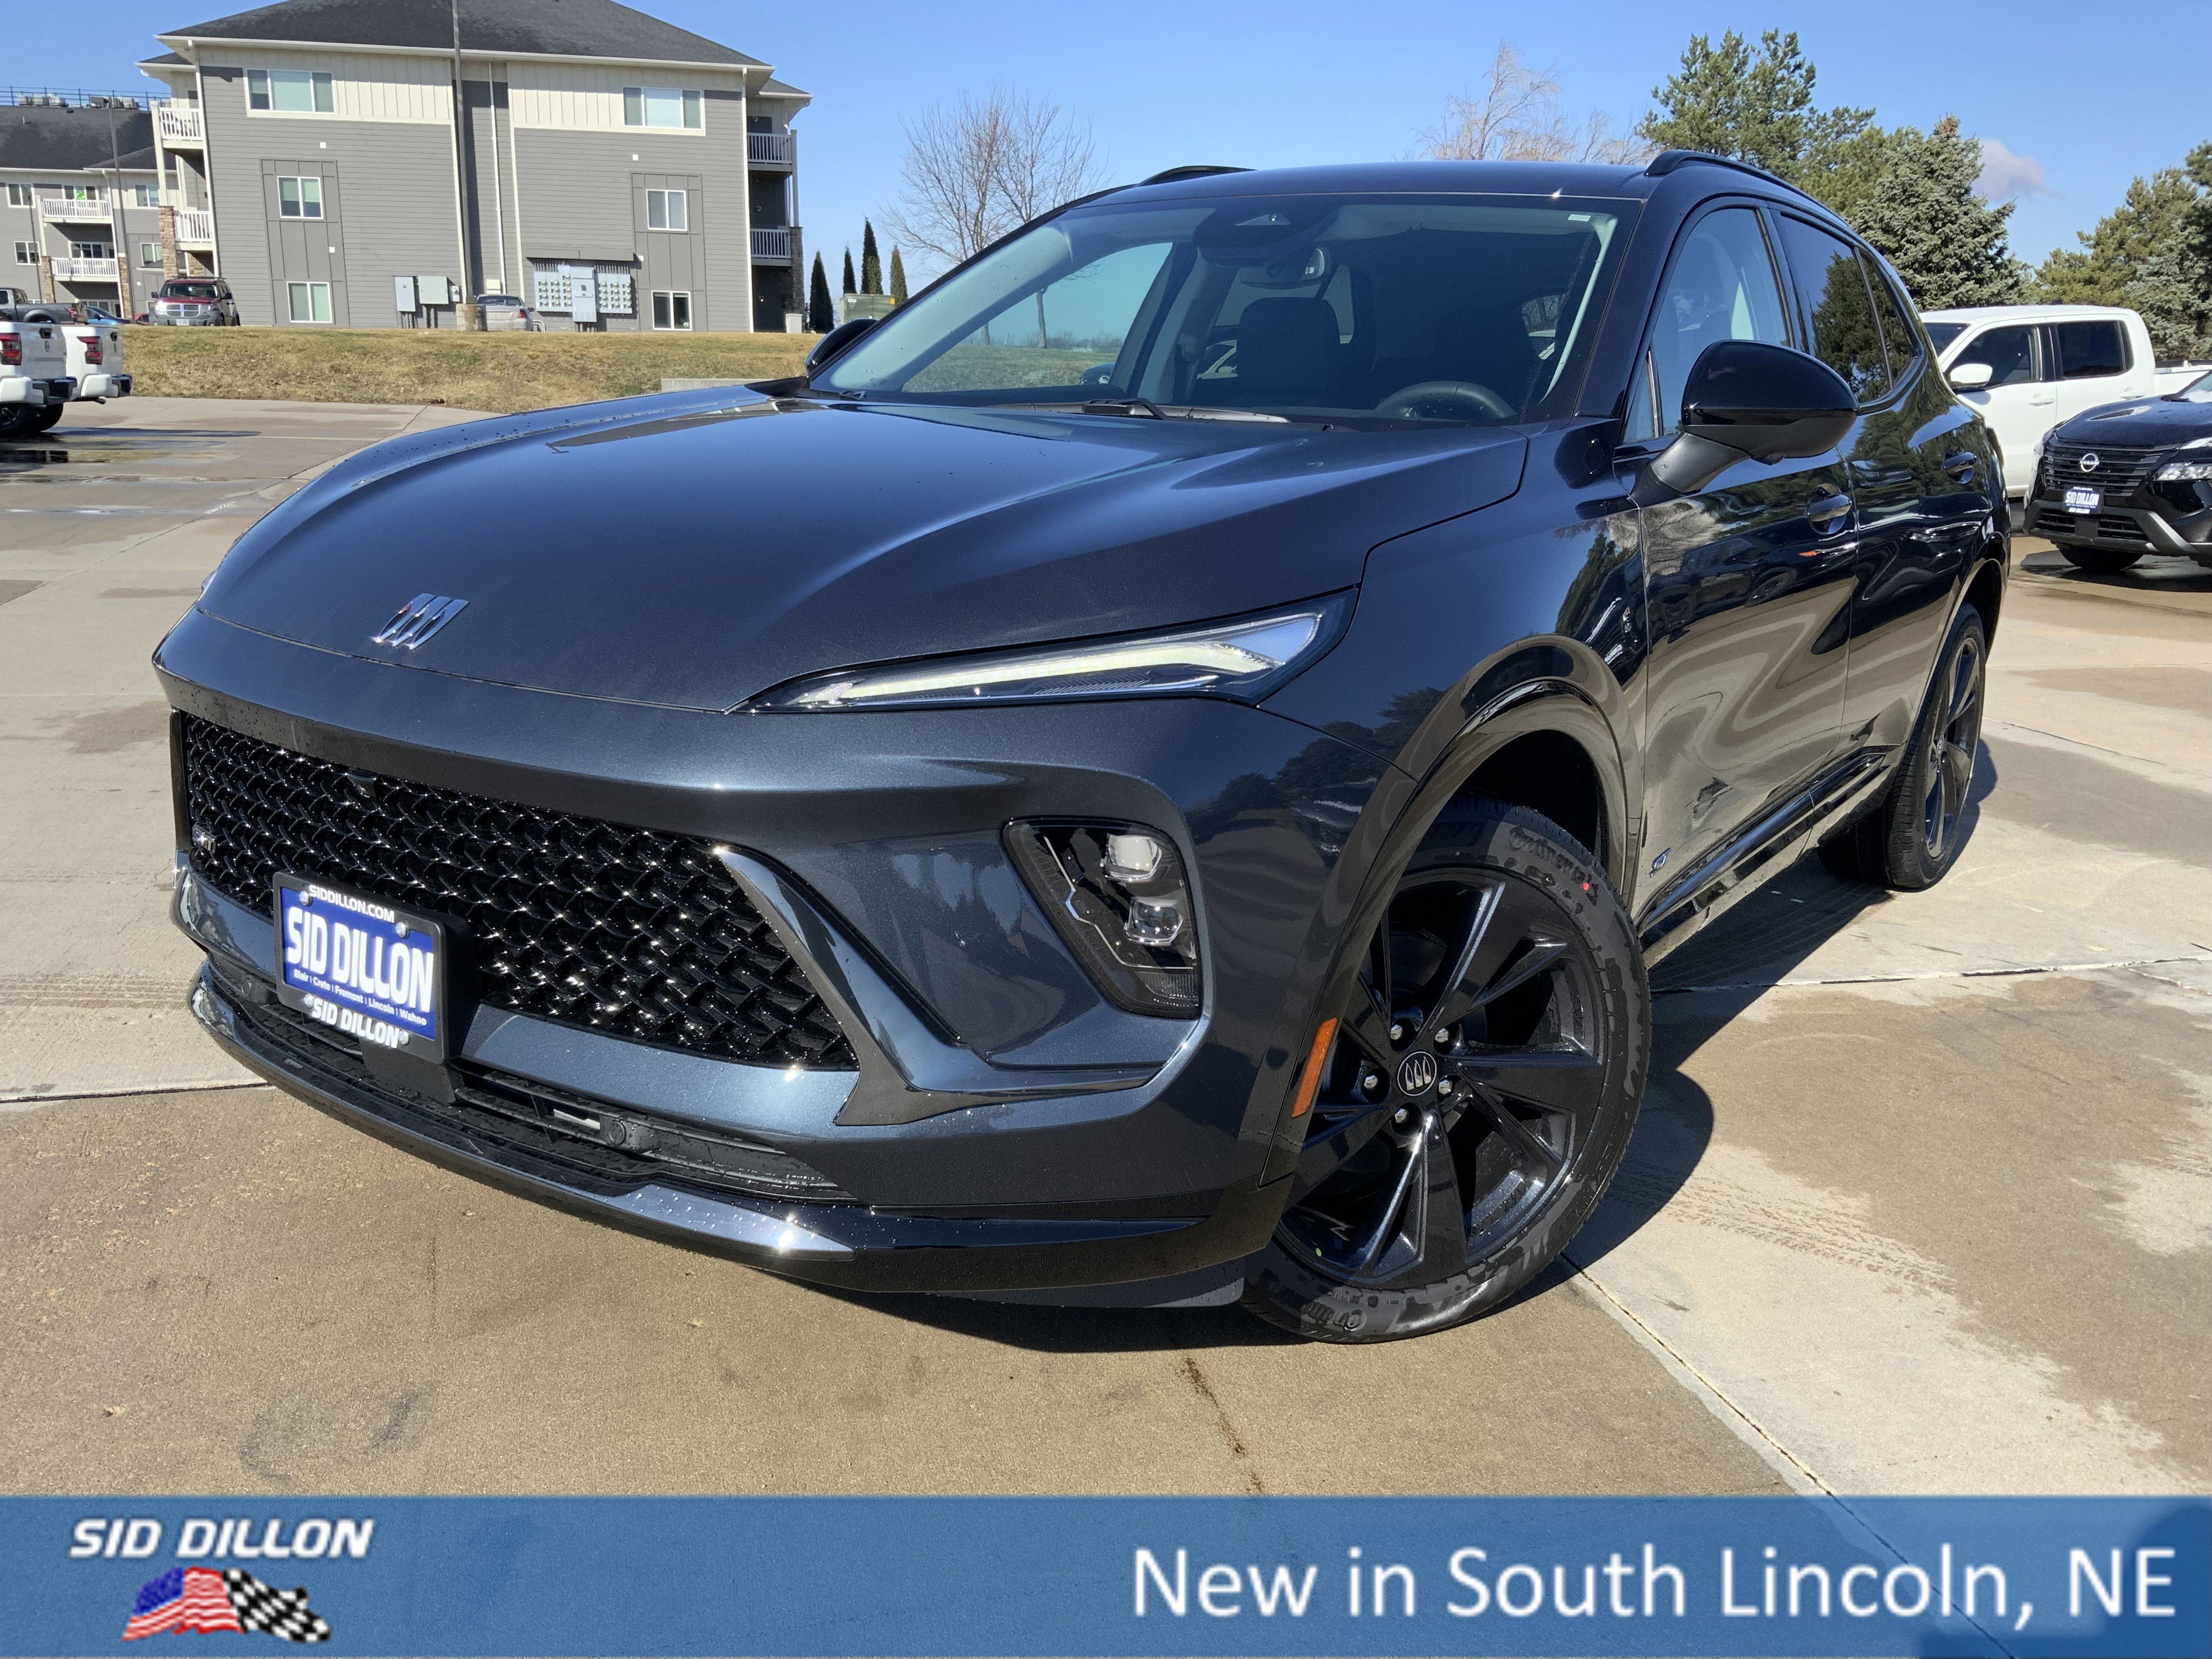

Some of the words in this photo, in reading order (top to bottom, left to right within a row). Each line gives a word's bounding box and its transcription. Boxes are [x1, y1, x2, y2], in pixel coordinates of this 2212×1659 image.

[2065, 491, 2077, 504] SID
[2076, 493, 2100, 506] DILLON
[309, 884, 394, 923] SIDDILLON.COM
[287, 906, 328, 974] SID
[332, 922, 434, 1013] DILLON
[294, 969, 309, 982] Blair
[313, 977, 331, 991] Crete
[335, 985, 364, 1004] Fremont
[368, 997, 394, 1015] Lincoln
[399, 1008, 427, 1026] Wahoo
[312, 998, 338, 1025] SID
[340, 1008, 400, 1048] DILLON
